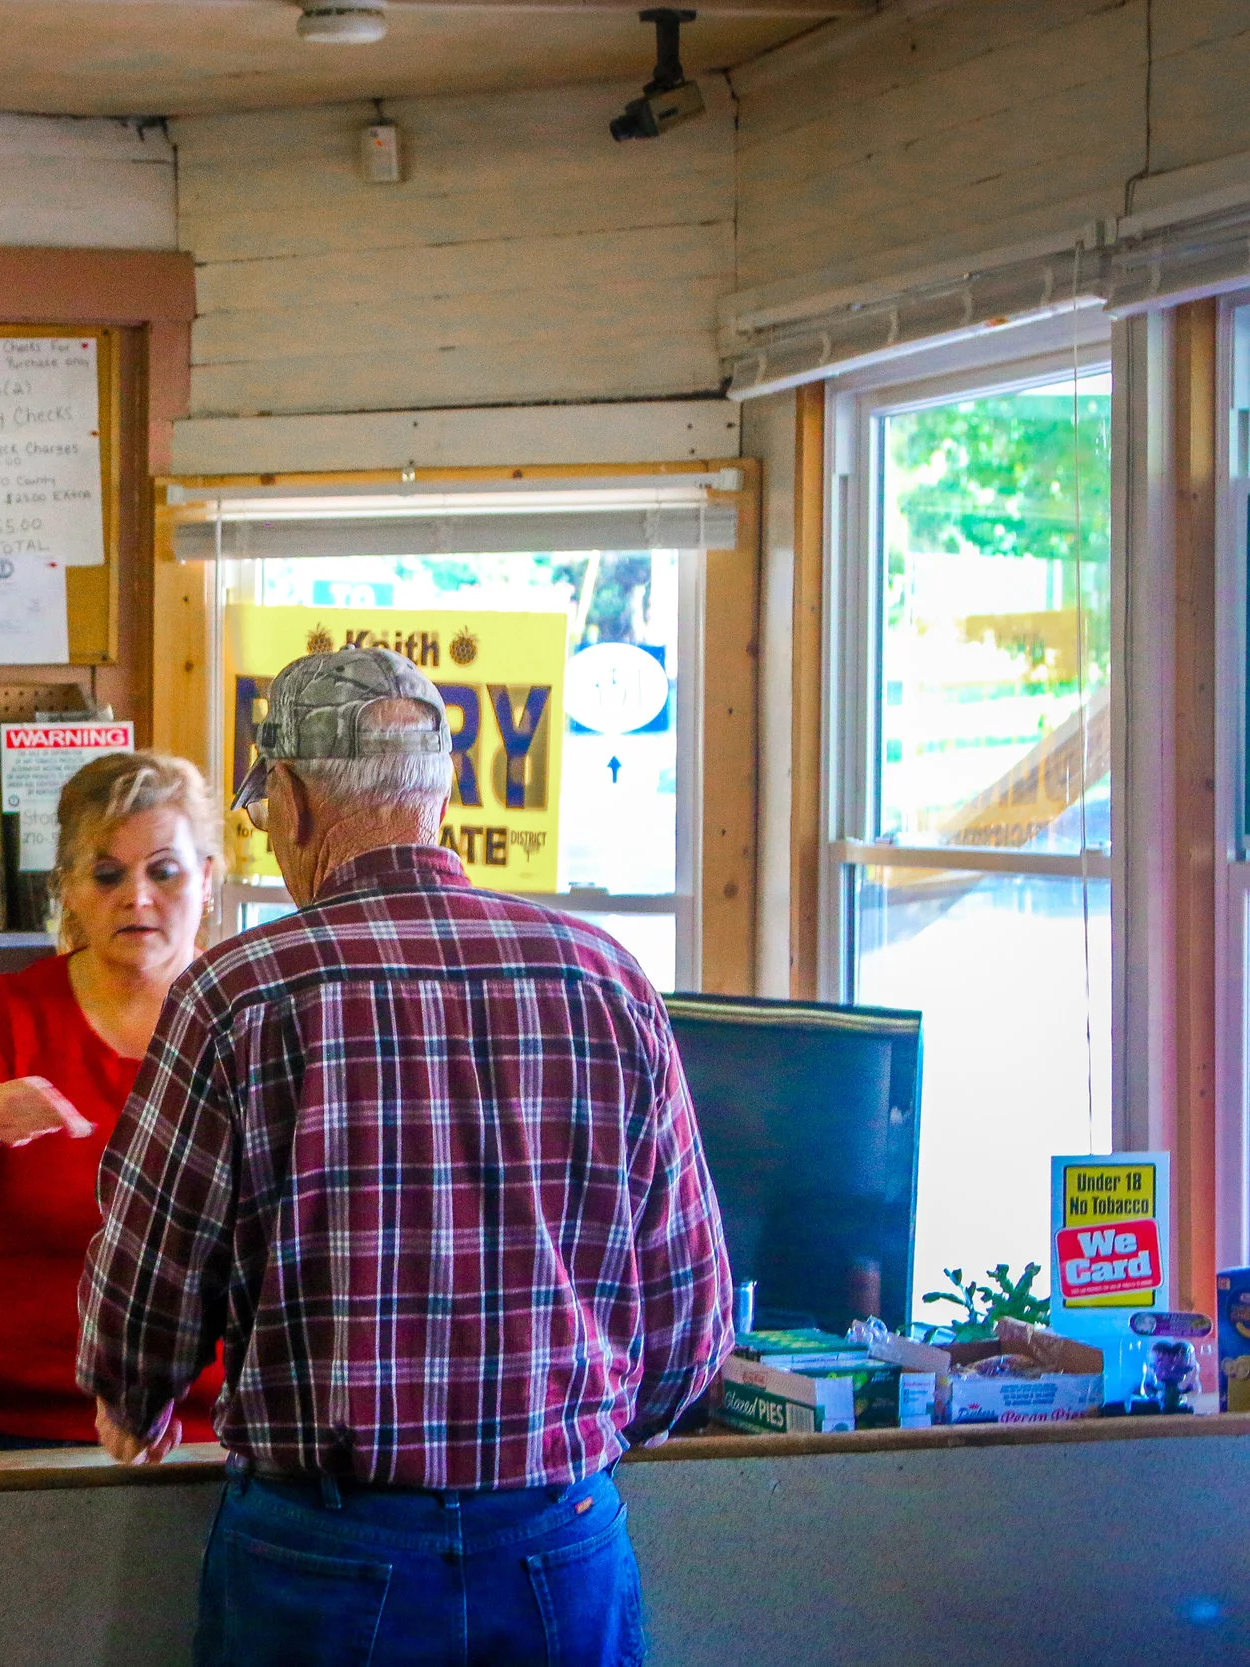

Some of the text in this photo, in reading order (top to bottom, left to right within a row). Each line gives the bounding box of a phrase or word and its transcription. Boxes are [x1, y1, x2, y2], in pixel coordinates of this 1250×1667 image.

[9, 729, 126, 748] WARNING
[1077, 1172, 1142, 1192] Under 18
[1070, 1194, 1150, 1215] No Tobacco
[1077, 1229, 1138, 1258] We
[1065, 1250, 1153, 1287] Card
[759, 1399, 784, 1427] PIES
